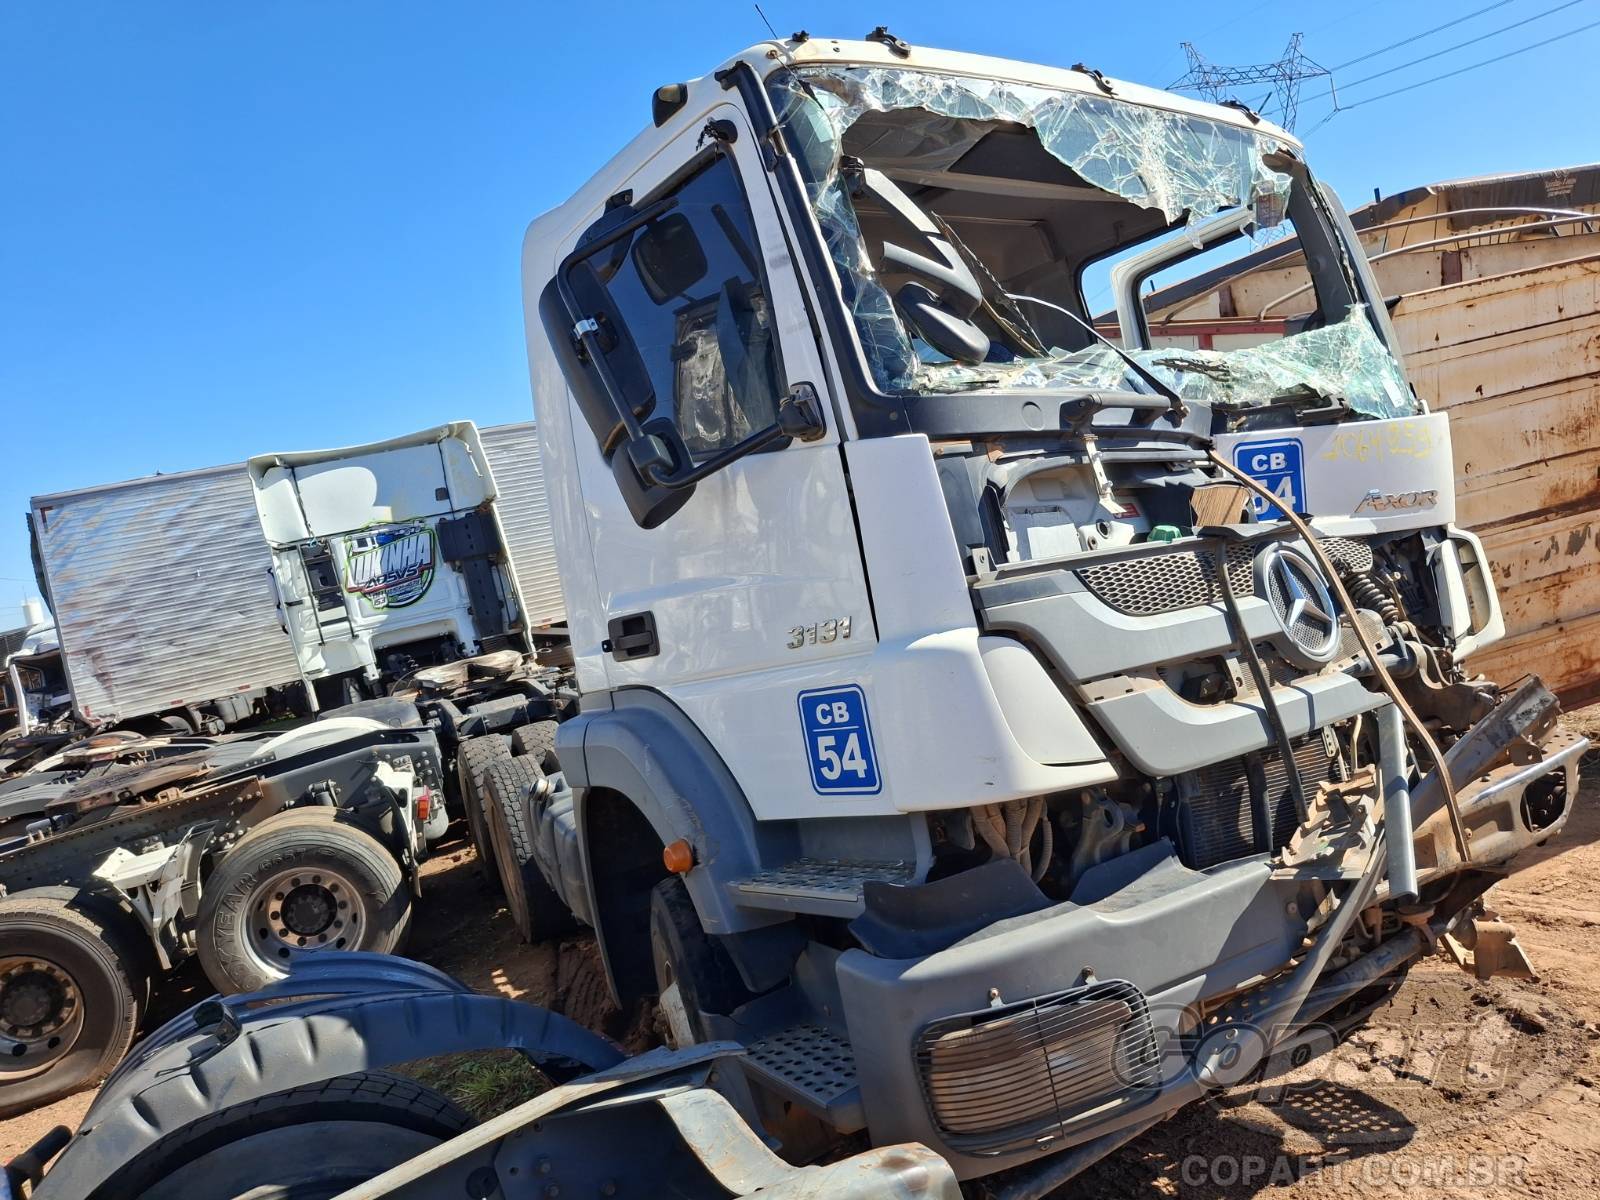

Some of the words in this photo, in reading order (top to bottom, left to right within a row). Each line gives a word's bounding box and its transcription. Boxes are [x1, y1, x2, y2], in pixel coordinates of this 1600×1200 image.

[1252, 452, 1287, 472] CB
[787, 615, 852, 650] 3131
[816, 701, 850, 725] CB
[817, 732, 868, 780] 54
